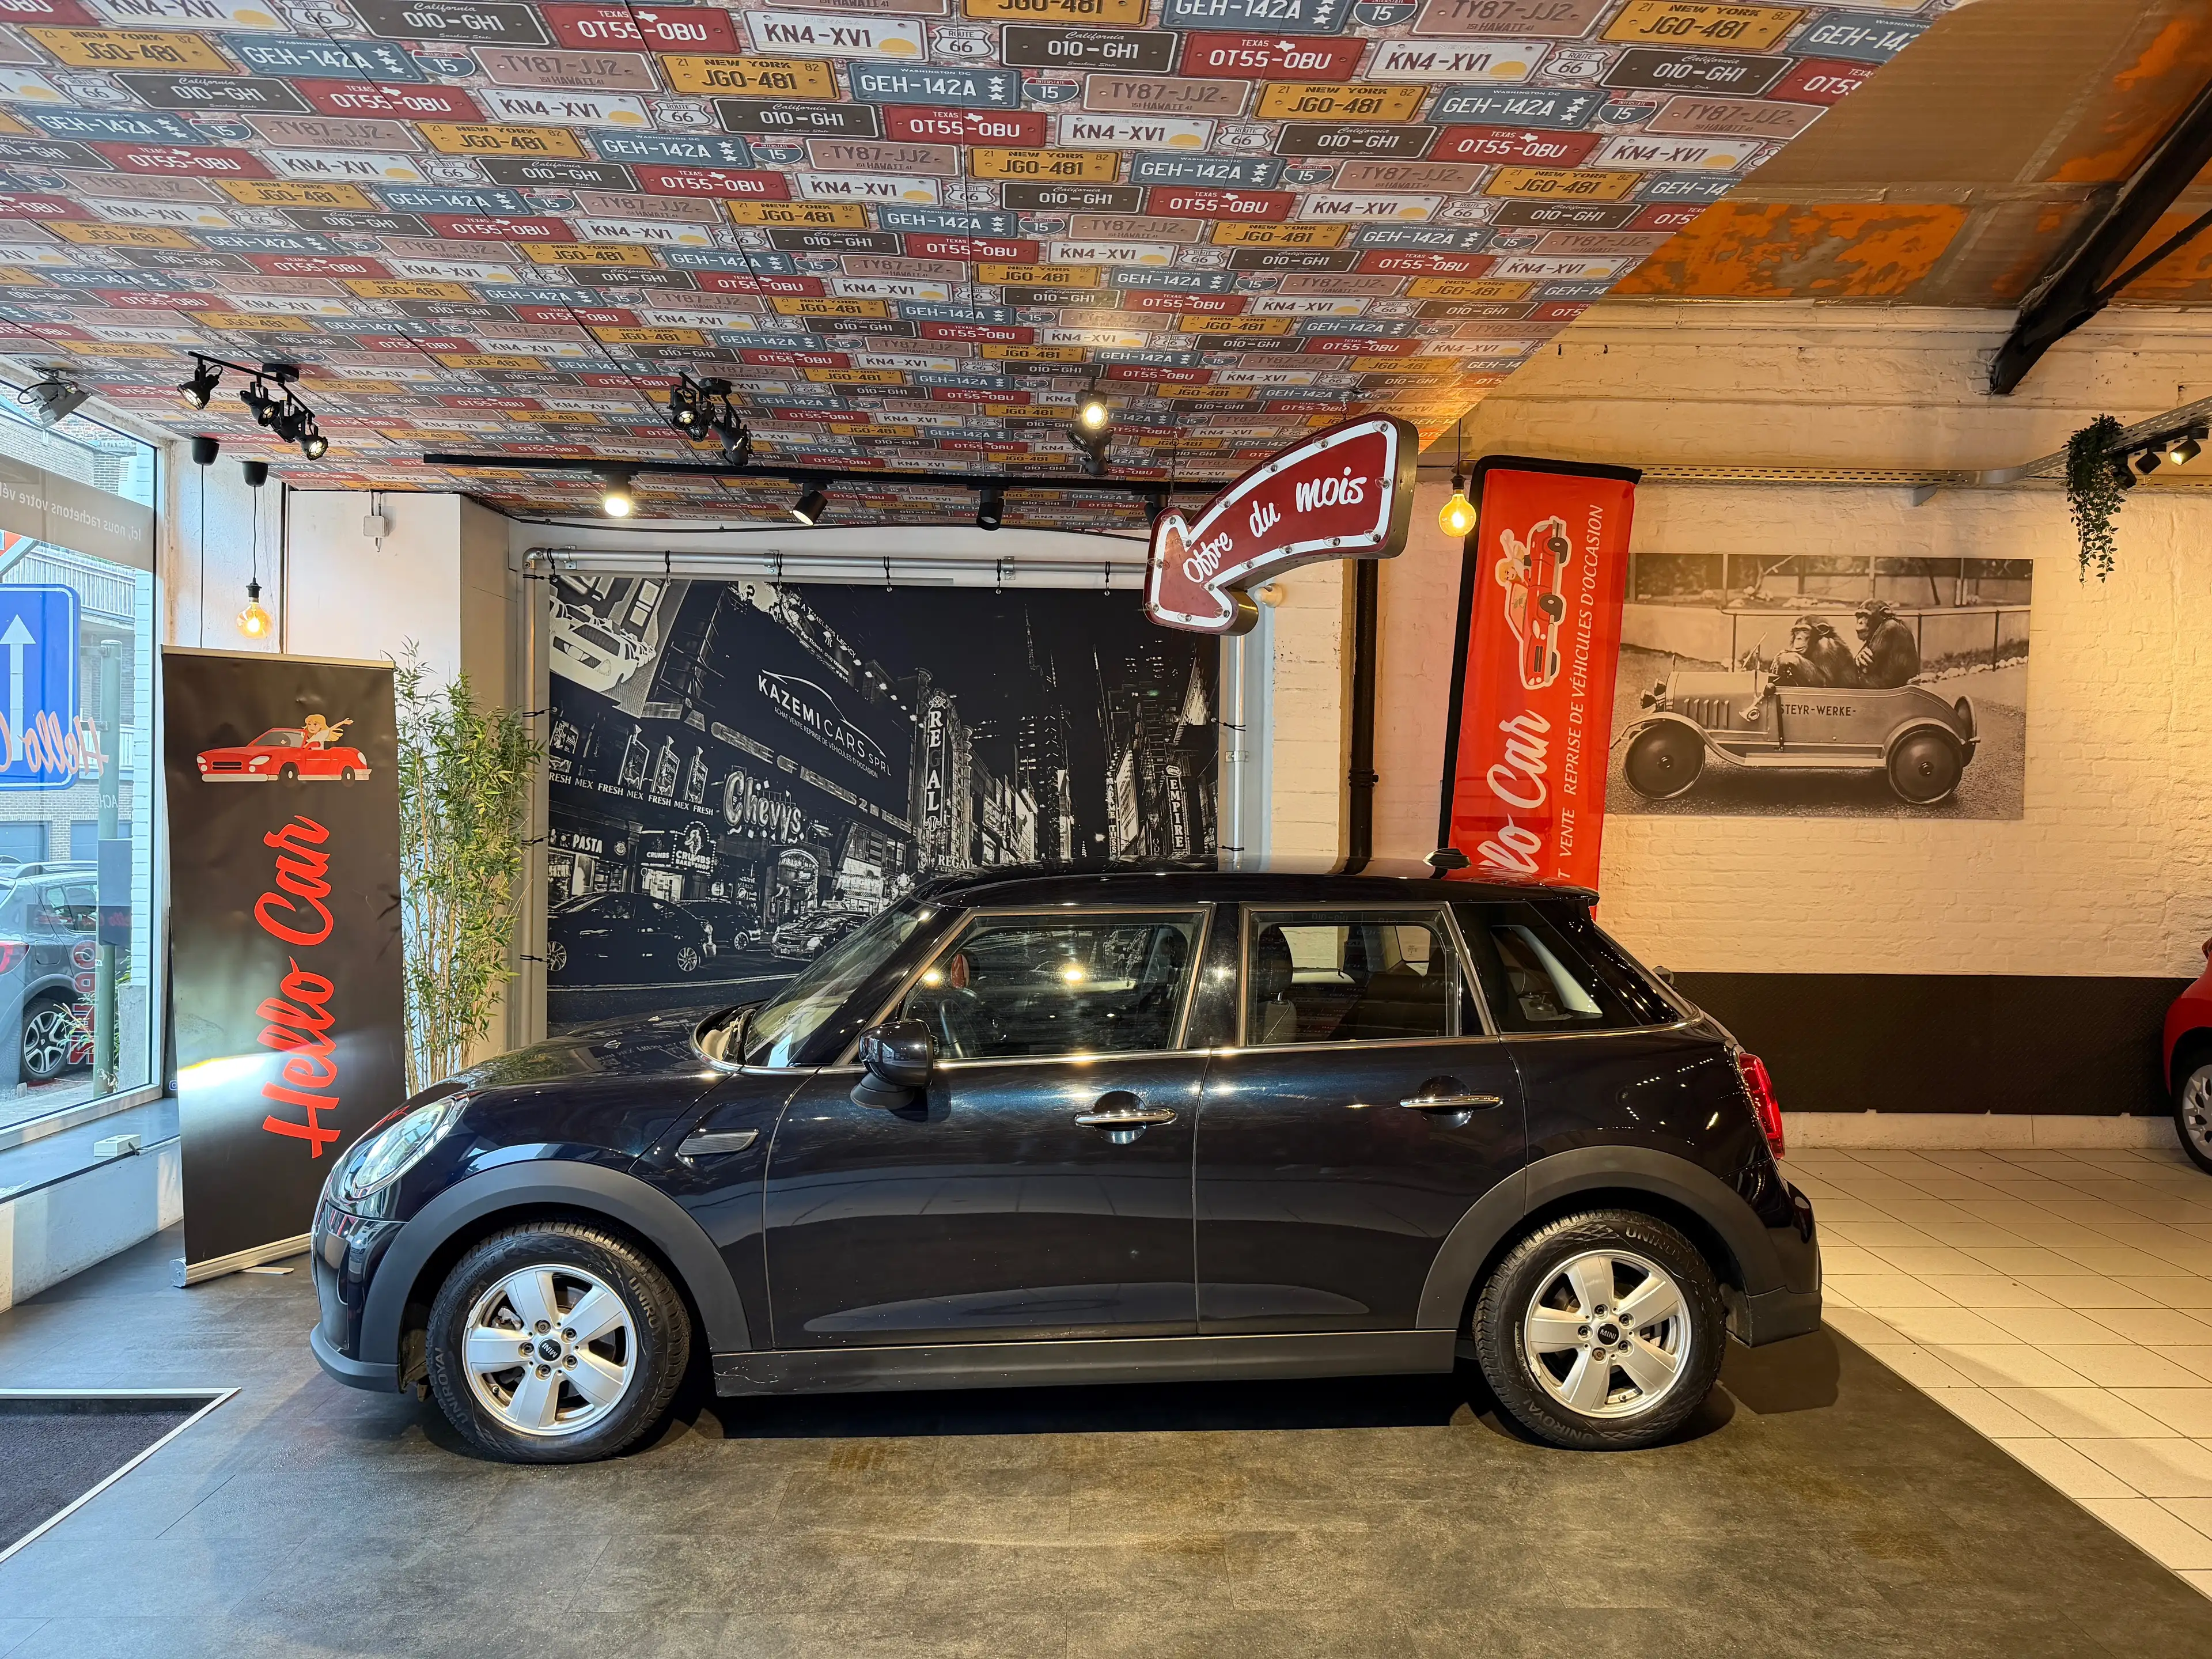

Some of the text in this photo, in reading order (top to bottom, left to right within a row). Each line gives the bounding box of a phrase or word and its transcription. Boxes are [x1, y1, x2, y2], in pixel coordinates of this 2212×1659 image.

[597, 10, 630, 18] TEXAS
[70, 31, 164, 41] NEW YORK
[763, 23, 873, 48] KN4-XV1
[1065, 30, 1126, 41] California
[1239, 39, 1271, 47] TEXAS
[948, 39, 975, 53] 66
[244, 46, 372, 69] GEH-142A
[432, 58, 459, 71] 15
[676, 58, 820, 72] 21 NEW YORK 82
[1384, 51, 1493, 71] KN4-XV1
[1681, 54, 1742, 65] California
[1557, 60, 1586, 74] 66
[175, 77, 237, 86] California
[345, 85, 376, 93] TEXAS
[860, 74, 978, 96] GEH-142A
[1037, 85, 1061, 98] 15
[1399, 89, 1415, 97] 82
[500, 98, 601, 118] KN4-XV1
[771, 103, 827, 112] California
[1441, 96, 1559, 116] GEH-142A
[1611, 106, 1637, 119] 15
[670, 111, 695, 122] 66
[1070, 123, 1168, 141] KN4-XV1
[602, 139, 711, 158] GEH-142A
[283, 158, 378, 175] KN4-XV1
[1139, 162, 1245, 179] GEH-142A
[810, 180, 898, 196] KN4-XV1
[887, 213, 983, 229] GEH-142A
[1361, 230, 1457, 244] GEH-142A
[1249, 500, 1281, 538] du
[1296, 465, 1368, 513] mois
[1569, 608, 1594, 699] VÉHICULES
[1569, 701, 1584, 726] DE
[758, 675, 892, 777] KAZEMI CARS SPRL
[774, 706, 789, 720] ACHAT
[789, 713, 804, 731] VENTE
[804, 723, 821, 742] REPRISE
[821, 736, 829, 747] DE
[926, 711, 944, 811] REGAL
[1487, 709, 1551, 809] Car
[1563, 727, 1581, 796] REPRISE
[575, 778, 593, 789] MEX
[597, 783, 624, 796] FRESH
[627, 790, 643, 800] MEX
[648, 794, 671, 806] FRESH
[673, 800, 689, 810] MEX
[693, 805, 714, 816] FRESH
[724, 771, 801, 843] Chevys
[1169, 779, 1187, 848] EMPIRE
[1559, 807, 1575, 857] VENTE
[573, 834, 603, 854] PASTA
[676, 850, 711, 864] CRUMBS
[254, 815, 341, 1160] Hello Car
[1600, 1328, 1617, 1340] MINI
[542, 1343, 558, 1358] MINI
